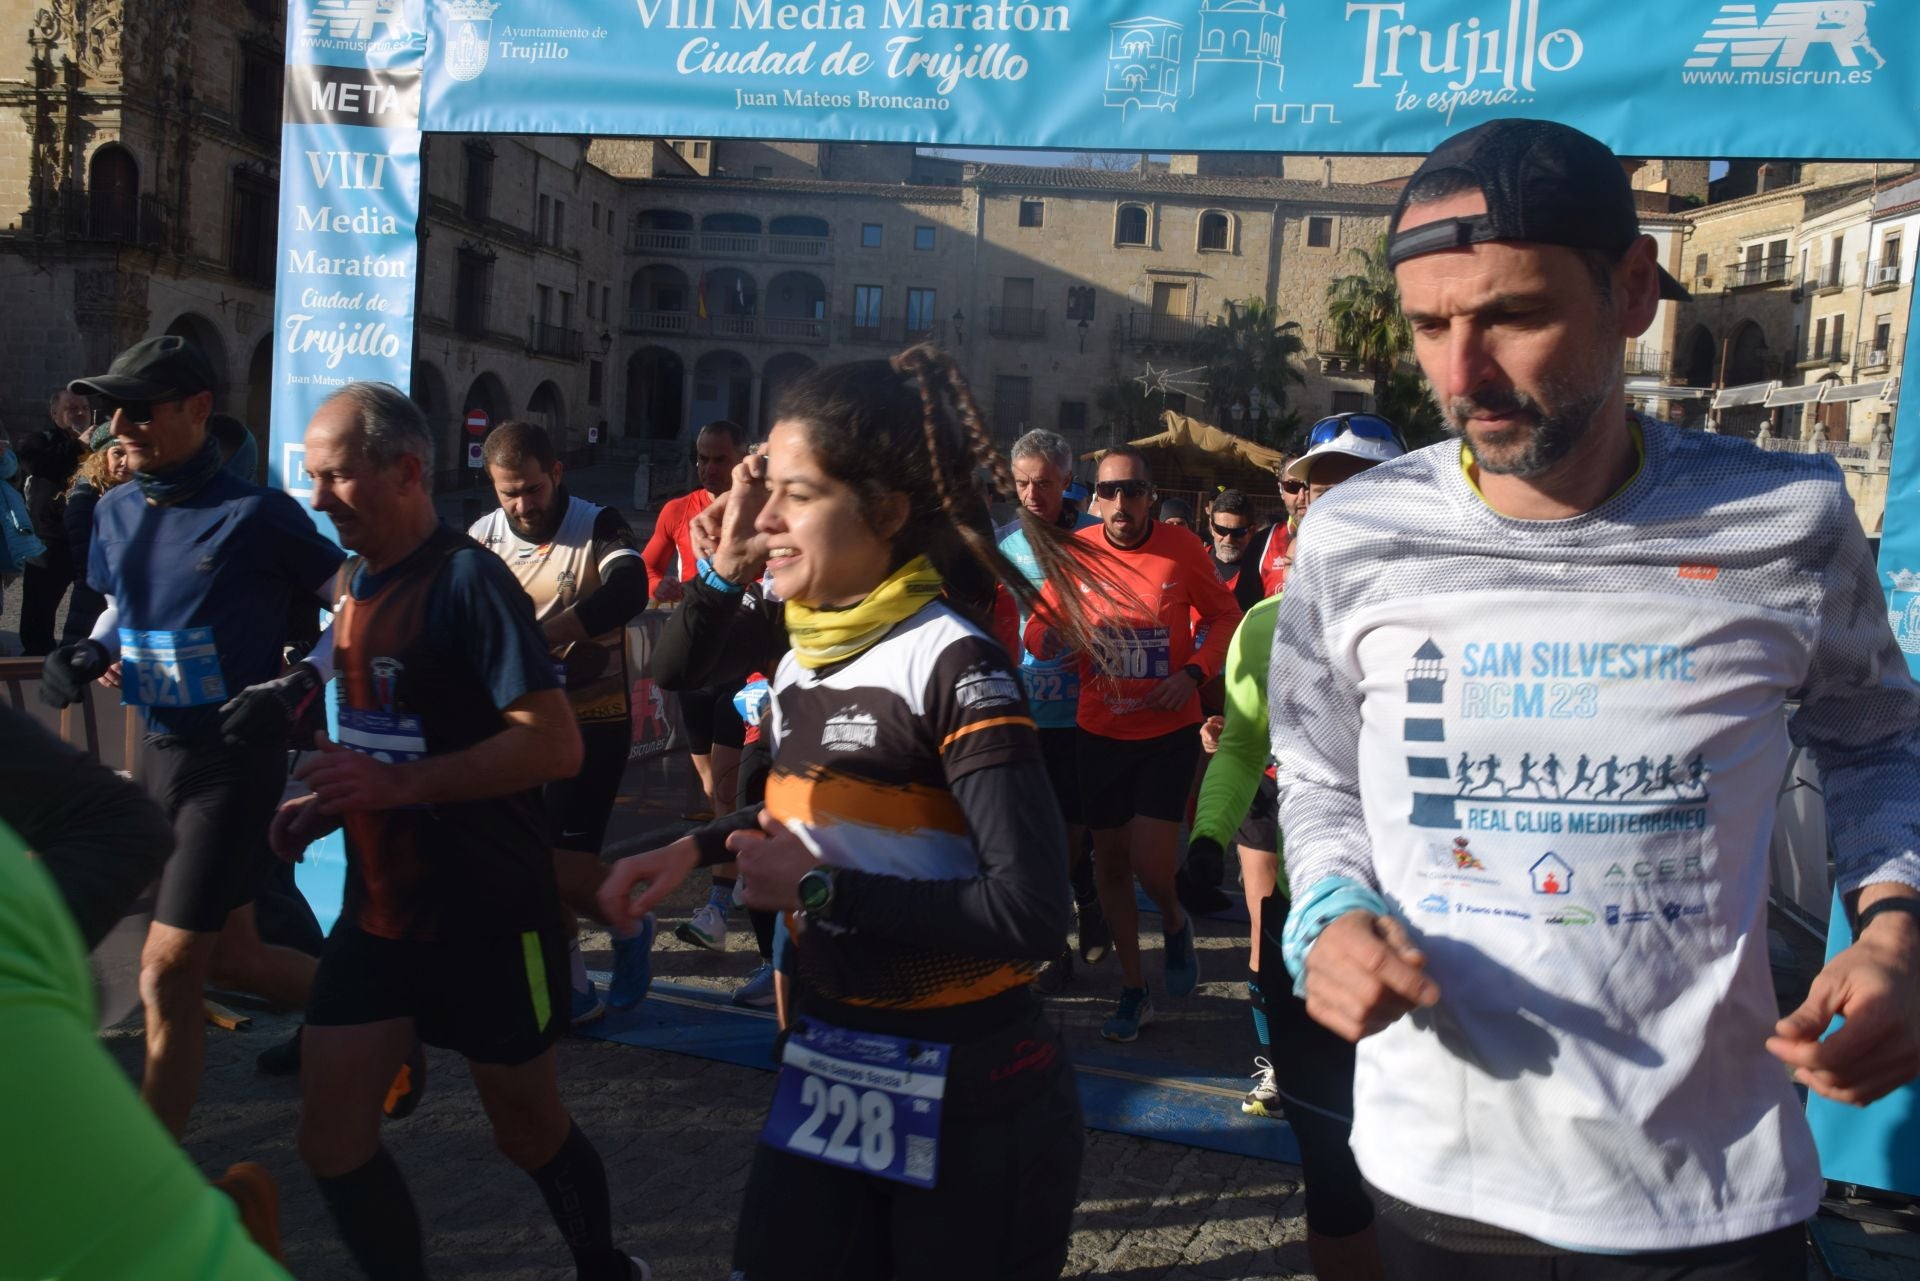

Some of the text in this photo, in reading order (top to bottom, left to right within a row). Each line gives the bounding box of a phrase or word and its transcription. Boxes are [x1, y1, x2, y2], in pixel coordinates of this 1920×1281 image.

[636, 0, 1071, 32] VIII Media Maratón
[502, 25, 608, 41] Ayuntamiento de
[1344, 0, 1584, 92] Trujillo
[500, 42, 569, 64] Trujillo
[676, 35, 1029, 96] Ciudad de Trujillo
[1681, 68, 1873, 85] www.musicrun.es
[311, 81, 402, 115] META
[735, 88, 950, 111] Juan Mateos Broncano
[1395, 80, 1536, 127] te espera...
[305, 151, 389, 190] VIII
[295, 205, 399, 235] Media
[287, 249, 407, 279] Maratón
[301, 287, 391, 312] Ciudad de
[285, 314, 400, 369] Trujillo
[287, 373, 311, 386] Juan
[312, 374, 346, 386] Mateos
[1460, 641, 1698, 683] SAN SILVESTRE
[1023, 672, 1063, 700] 522
[1460, 682, 1598, 719] RCM 23
[1468, 807, 1508, 831] REAL
[1515, 809, 1562, 834] CLUB
[1603, 856, 1701, 879] ACER
[786, 1073, 896, 1171] 228
